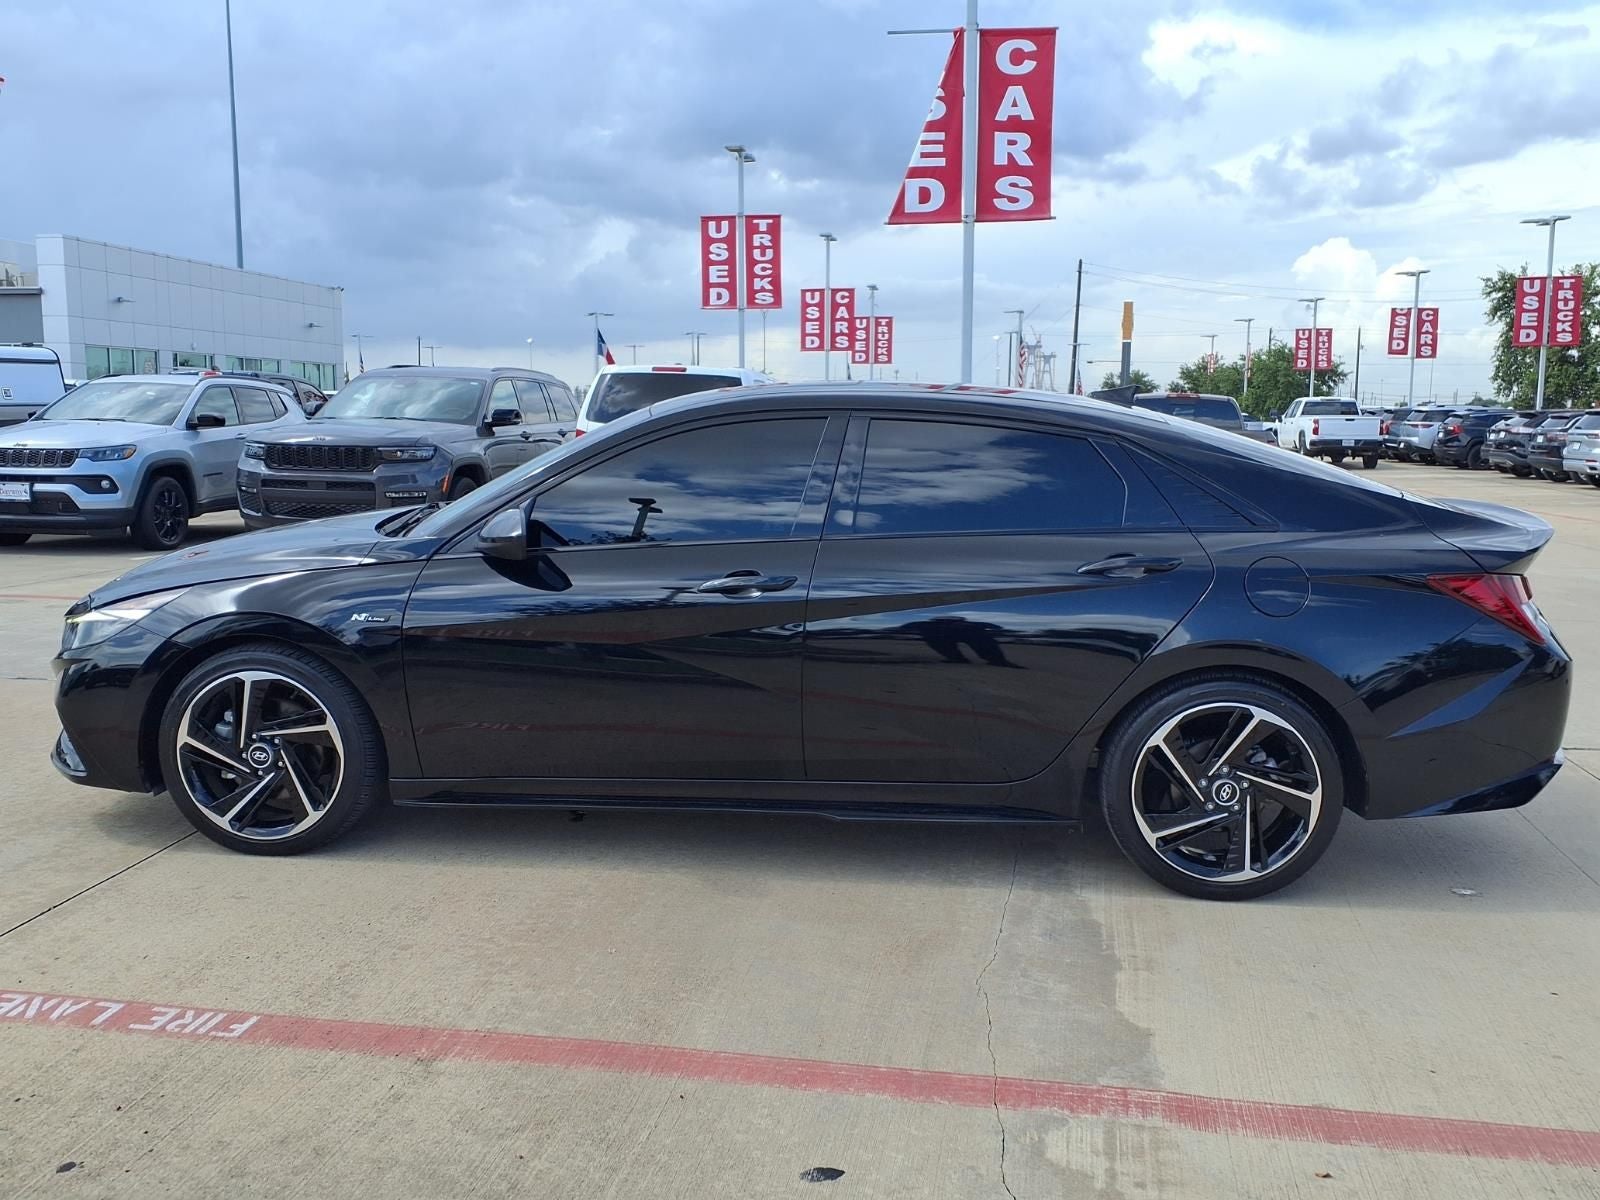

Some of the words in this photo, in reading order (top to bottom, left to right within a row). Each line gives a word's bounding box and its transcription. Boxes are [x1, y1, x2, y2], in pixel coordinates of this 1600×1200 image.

[992, 38, 1038, 211] CARS
[708, 220, 730, 306] USED
[752, 219, 774, 305] TRUCKS
[805, 291, 820, 349] USED
[835, 291, 850, 348] CARS
[1420, 310, 1434, 356] CARS
[1519, 279, 1541, 343] USED
[1556, 278, 1575, 343] TRUCKS
[855, 318, 867, 362] USED
[877, 318, 889, 362] TRUCKS
[1297, 330, 1309, 367] USED
[1318, 329, 1329, 367] TRUCKS
[128, 1006, 261, 1038] FIRE
